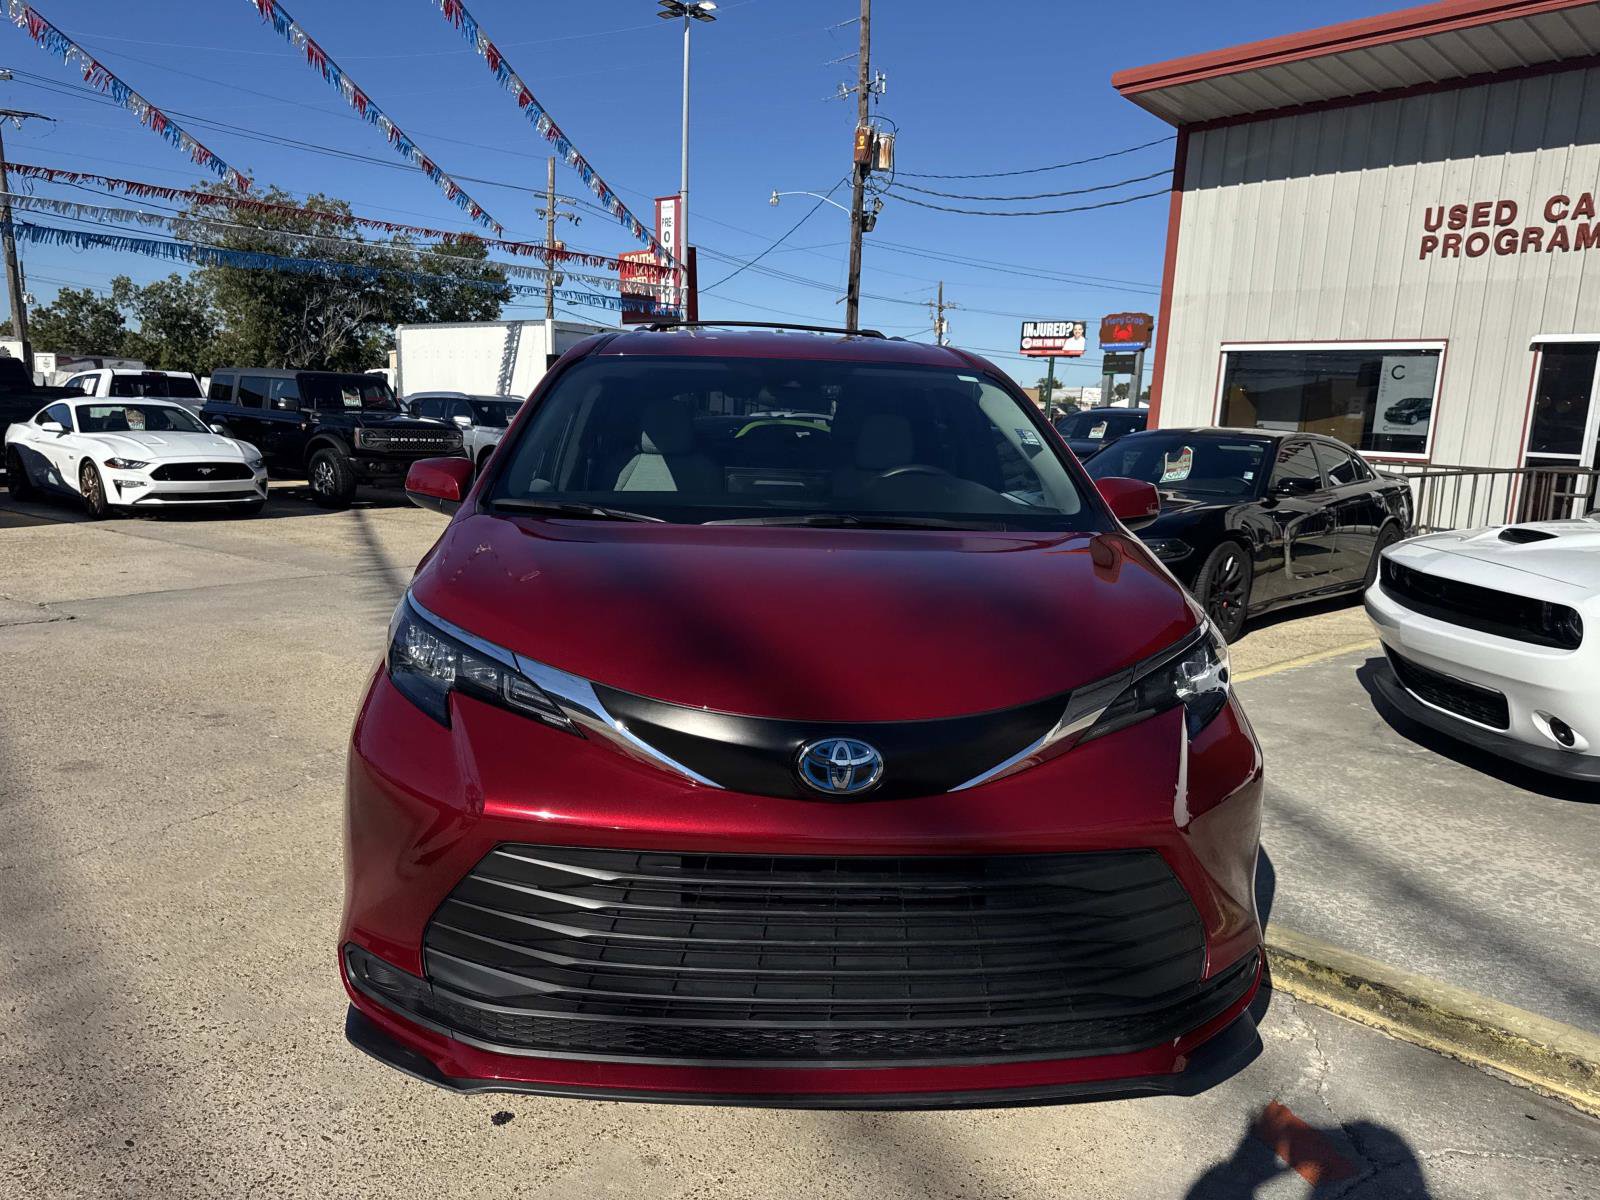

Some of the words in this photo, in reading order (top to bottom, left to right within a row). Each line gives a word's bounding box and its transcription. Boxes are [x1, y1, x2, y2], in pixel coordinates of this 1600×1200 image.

[1424, 200, 1518, 233] USED
[1543, 192, 1597, 224] CA
[1419, 222, 1600, 260] PROGRAM
[1023, 322, 1073, 337] INJURED?
